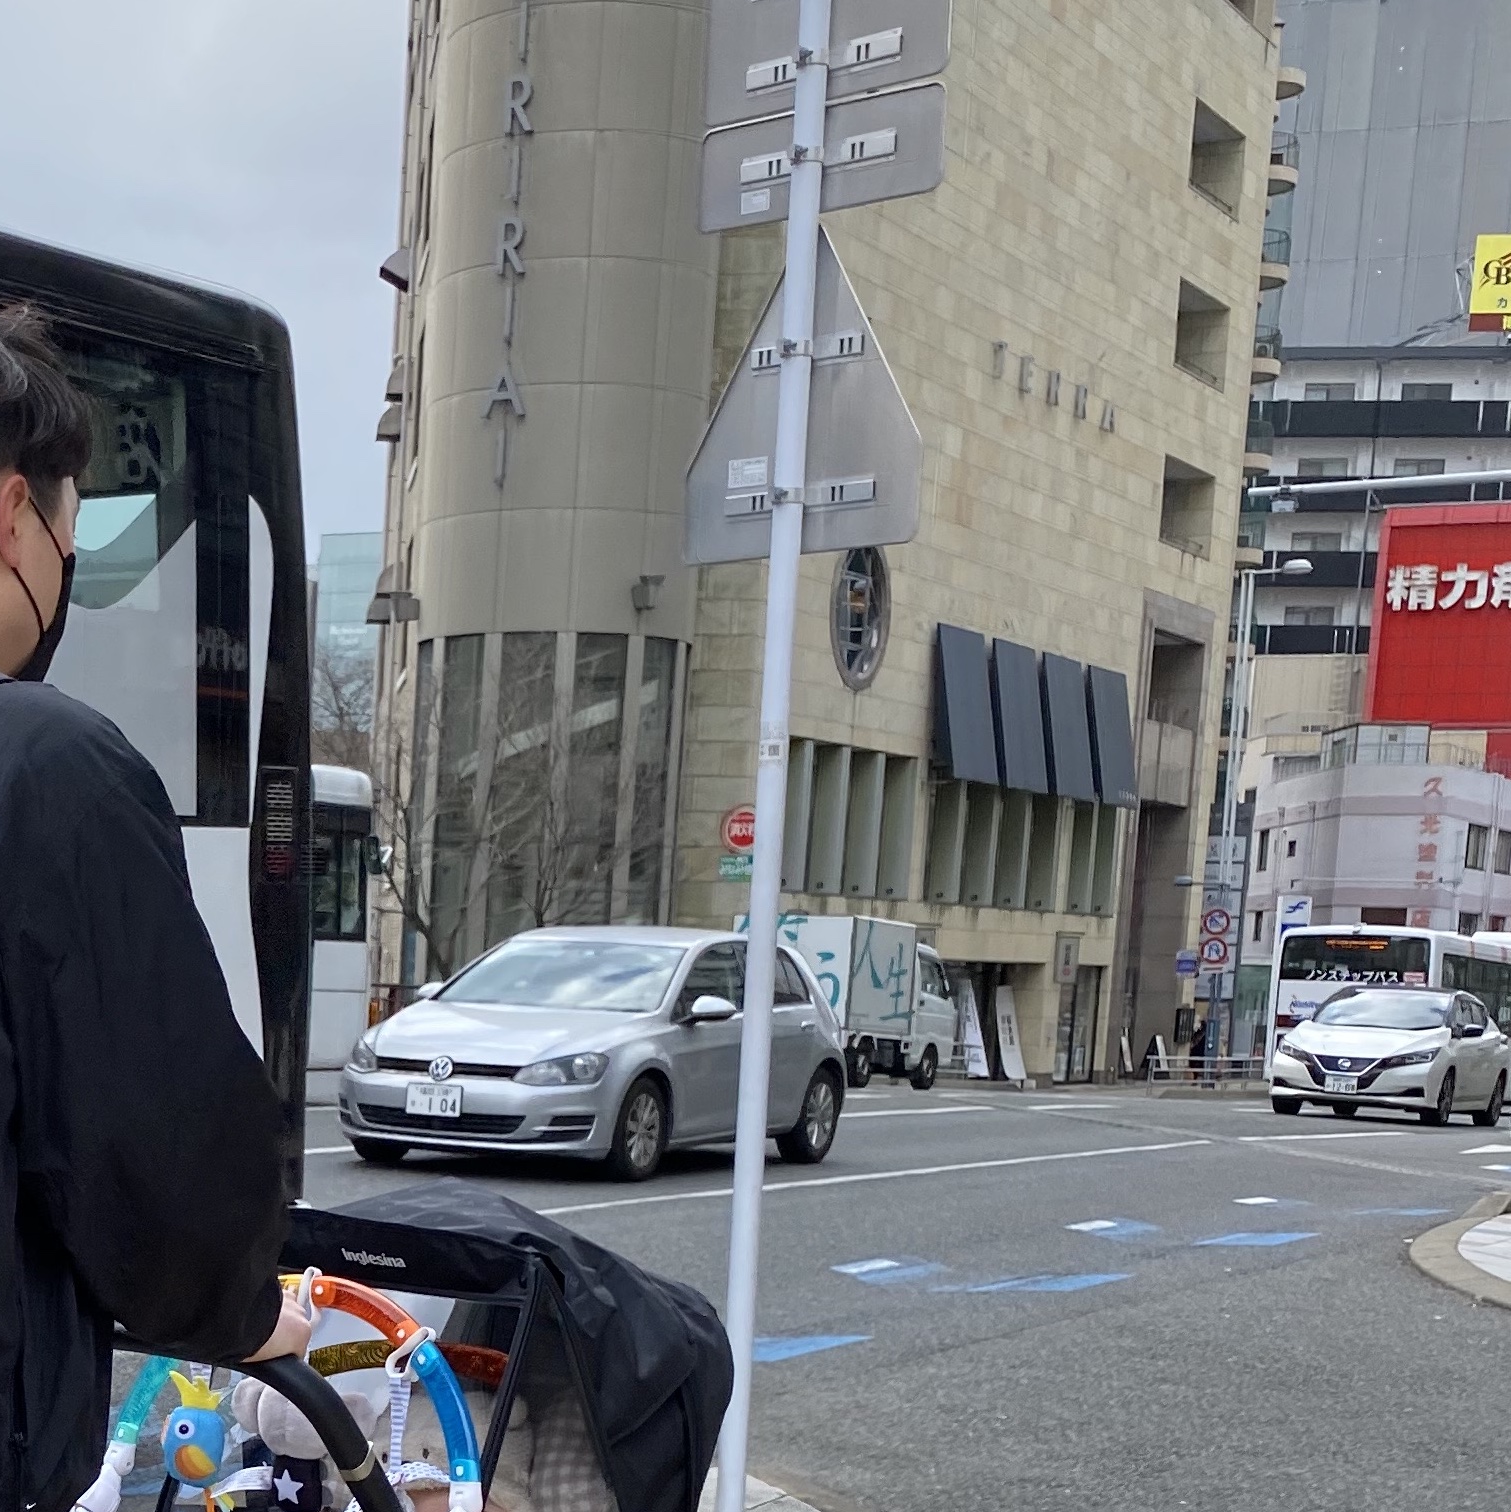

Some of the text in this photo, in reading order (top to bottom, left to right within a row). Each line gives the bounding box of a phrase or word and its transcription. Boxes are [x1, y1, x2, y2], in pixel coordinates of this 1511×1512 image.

[1305, 968, 1399, 983] ノンステップバス
